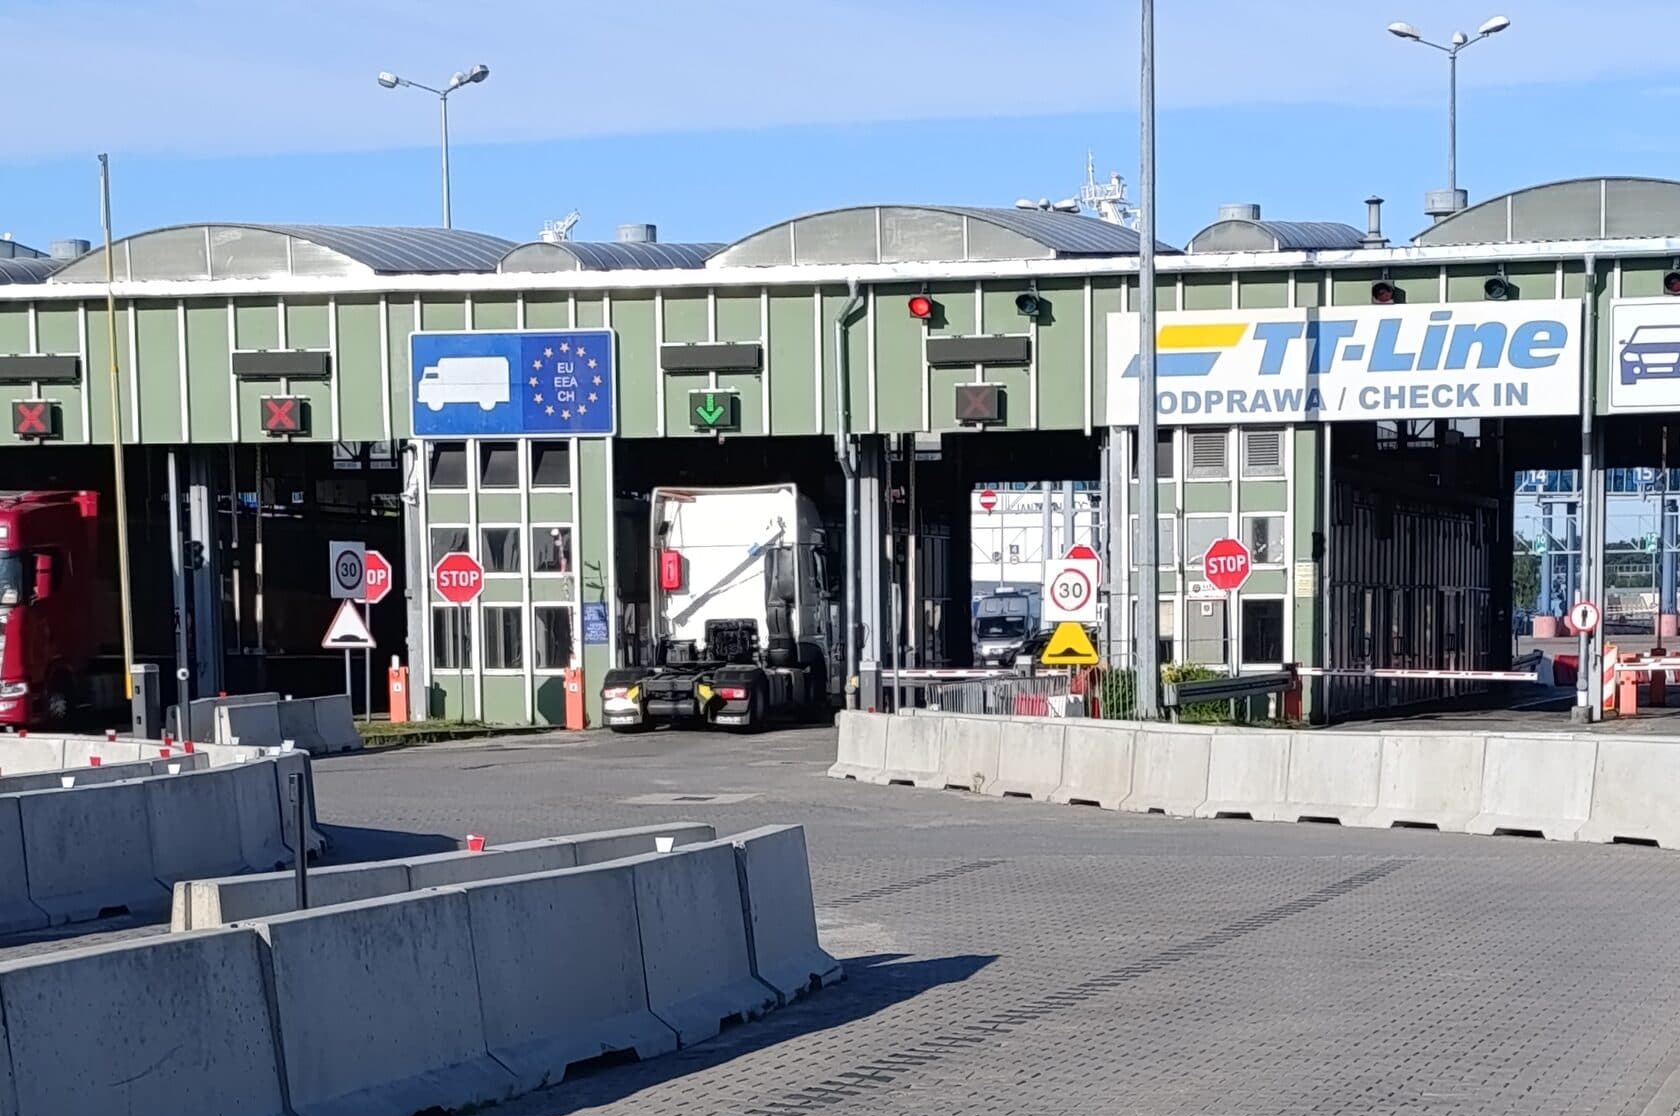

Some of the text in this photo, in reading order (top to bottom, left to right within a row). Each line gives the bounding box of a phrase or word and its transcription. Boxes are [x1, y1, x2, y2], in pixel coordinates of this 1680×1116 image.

[1253, 311, 1568, 375] TT-Line
[557, 362, 574, 373] EU
[554, 376, 578, 388] EEA
[557, 391, 575, 402] CH
[1156, 382, 1529, 414] ODPRAWA / CHECK IN
[1528, 469, 1546, 482] 14
[341, 562, 357, 577] 30
[1208, 554, 1246, 575] STOP
[366, 569, 387, 585] OP
[440, 570, 480, 587] STOP
[1059, 582, 1083, 599] 30
